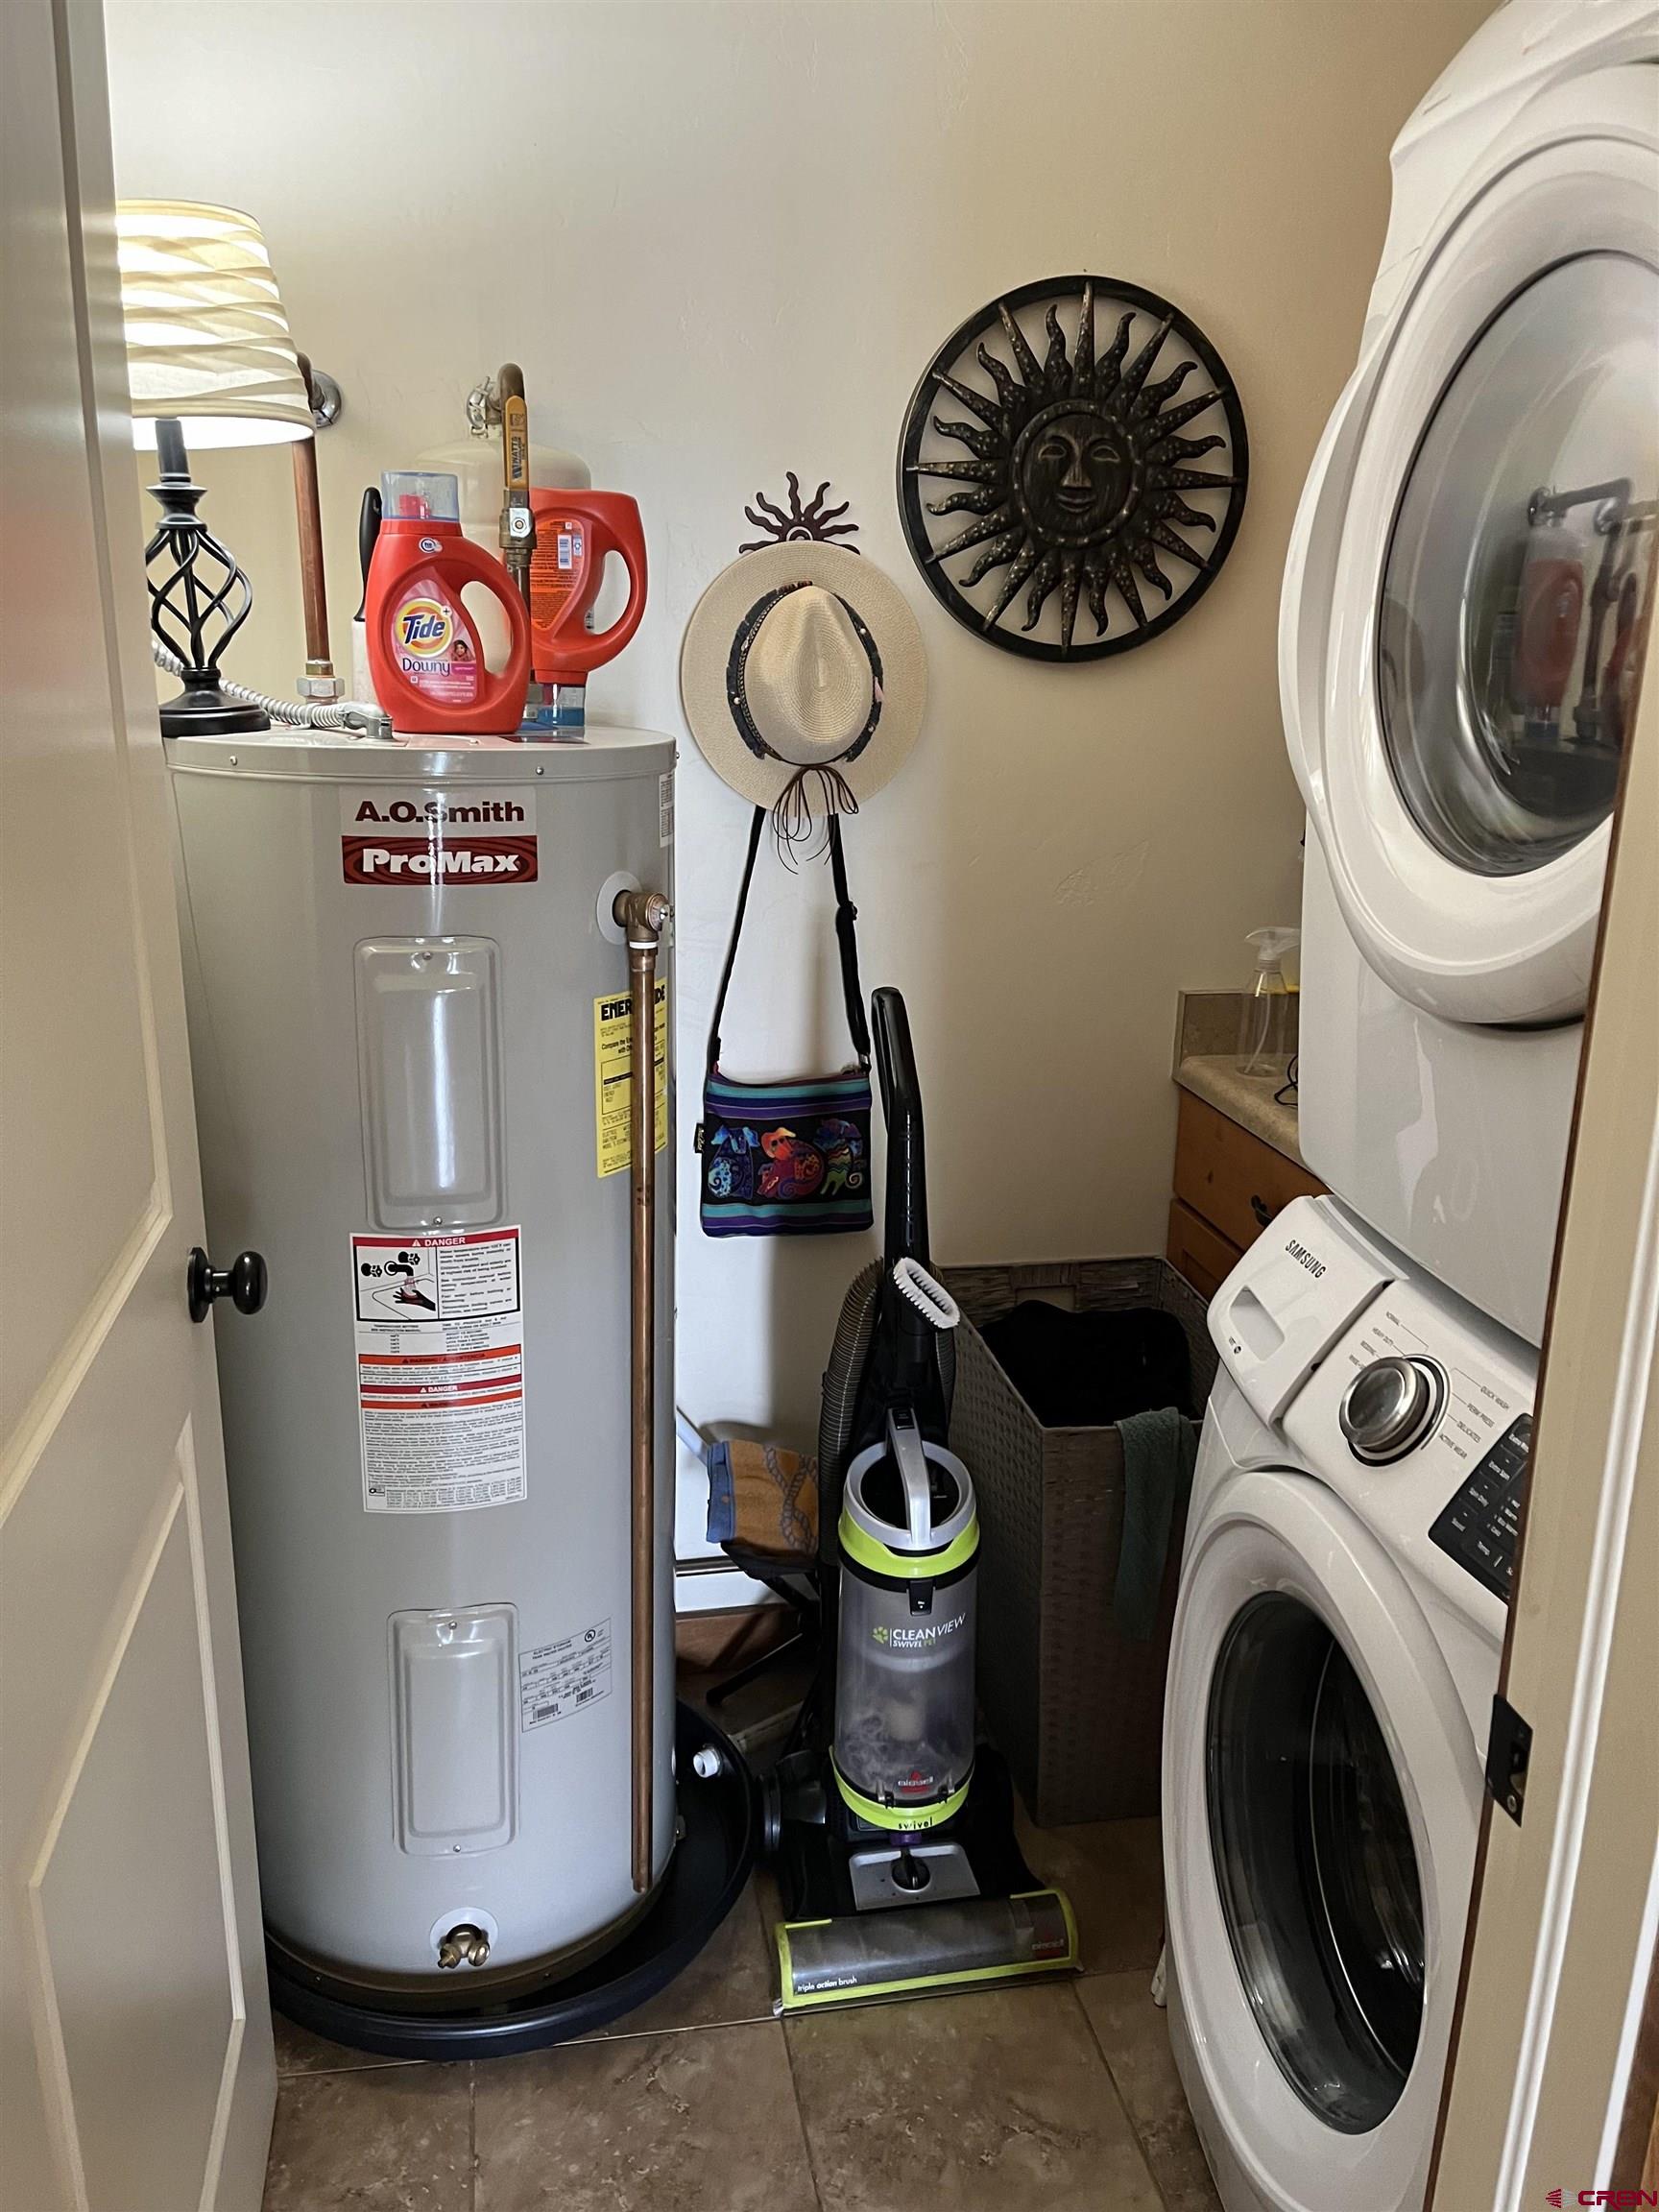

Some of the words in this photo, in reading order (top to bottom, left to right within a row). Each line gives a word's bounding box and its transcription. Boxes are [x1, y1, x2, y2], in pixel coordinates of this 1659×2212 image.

[402, 614, 445, 644] Tide
[402, 658, 450, 677] Downy
[362, 848, 520, 874] ProMax
[424, 1237, 466, 1247] DANGER
[1285, 1239, 1327, 1279] SAMSUNG
[1456, 1420, 1481, 1443] DELICATES
[892, 1639, 923, 1648] SWIVEL
[898, 1816, 934, 1830] swivel
[797, 1983, 815, 1993] triple
[816, 1980, 838, 1989] action
[838, 1975, 858, 1985] brush
